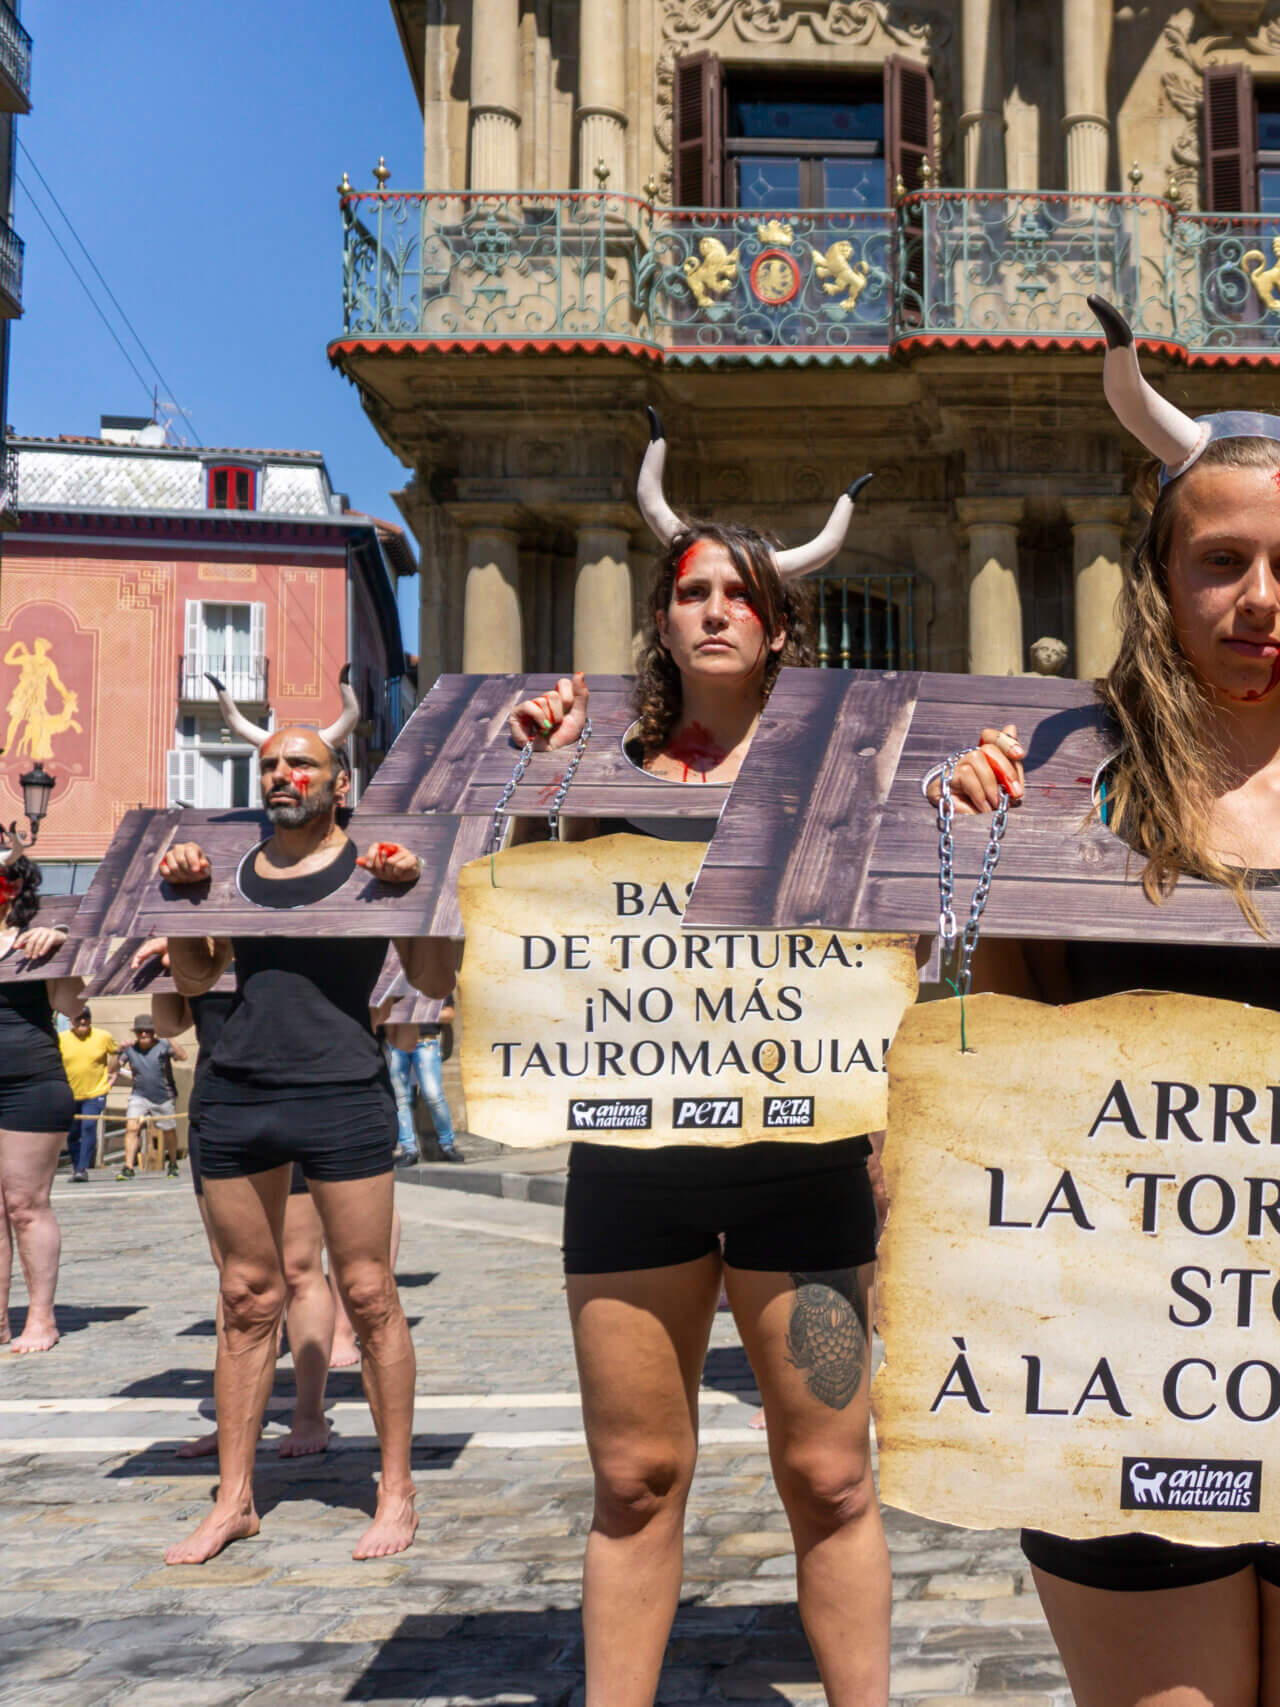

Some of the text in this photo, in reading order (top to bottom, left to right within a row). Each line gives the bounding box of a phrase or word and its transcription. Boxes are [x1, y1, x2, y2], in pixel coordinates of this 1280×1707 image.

[612, 881, 695, 916] BA
[521, 933, 864, 970] DE TORTURA:
[585, 978, 803, 1033] ¡NO MÁS
[491, 1037, 889, 1083] TAUROMAQUIA!
[595, 1114, 647, 1127] naturalis
[596, 1101, 647, 1115] anima
[767, 1116, 810, 1125] LATINO
[985, 1167, 1095, 1231] LA
[929, 1336, 991, 1414] À
[1021, 1354, 1132, 1417] LA
[1169, 1465, 1253, 1489] anima
[1168, 1487, 1253, 1507] naturalis
